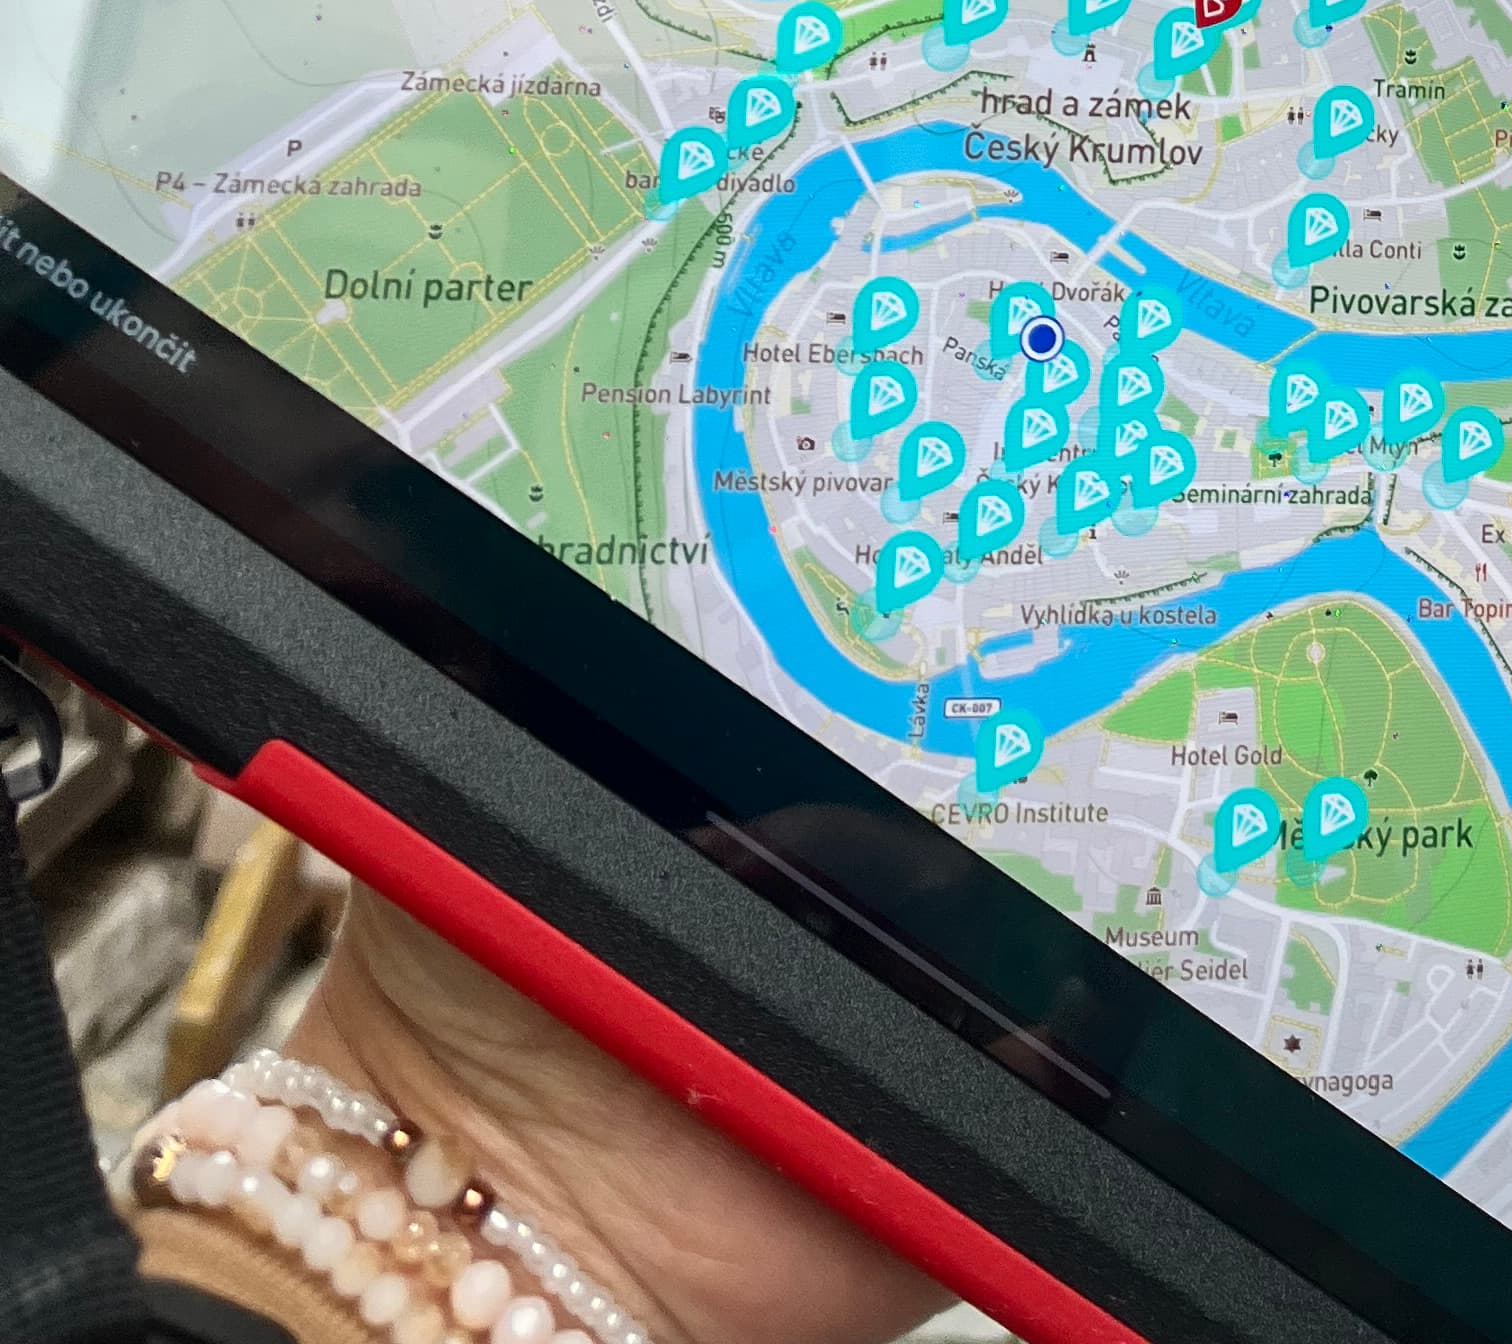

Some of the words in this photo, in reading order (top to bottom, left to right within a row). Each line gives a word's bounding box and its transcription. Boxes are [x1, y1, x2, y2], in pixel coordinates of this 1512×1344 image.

[401, 71, 504, 95] Zámecká
[510, 74, 601, 102] jízdárna
[981, 86, 1052, 117] hrad
[1089, 87, 1191, 120] zámek
[965, 121, 1060, 169] Český
[1069, 133, 1203, 166] Krumlov
[212, 171, 321, 196] Zámecká
[328, 176, 421, 197] zahrada
[716, 173, 796, 195] divadlo
[1369, 240, 1422, 260] Conti
[325, 268, 415, 301] Dolní
[423, 272, 534, 309] parter
[1052, 280, 1125, 302] Dvořák
[16, 242, 89, 299] nebo
[90, 290, 197, 375] ukončit
[1310, 286, 1476, 320] Pivovarská
[743, 342, 800, 364] Hotel
[581, 383, 673, 405] Pension
[678, 385, 771, 412] Labyrint
[714, 470, 806, 496] Městský
[812, 473, 893, 497] pivovar
[1288, 485, 1373, 506] zahrada
[1020, 604, 1113, 629] Vyhlídka
[1139, 605, 1217, 625] kostela
[1417, 598, 1456, 618] Bar
[908, 681, 930, 739] Lávka
[1170, 746, 1227, 767] Hotel
[1234, 746, 1283, 767] Gold
[1016, 802, 1109, 824] Institute
[1402, 817, 1473, 857] park
[1106, 926, 1200, 947] Museum
[1180, 958, 1249, 982] Seidel
